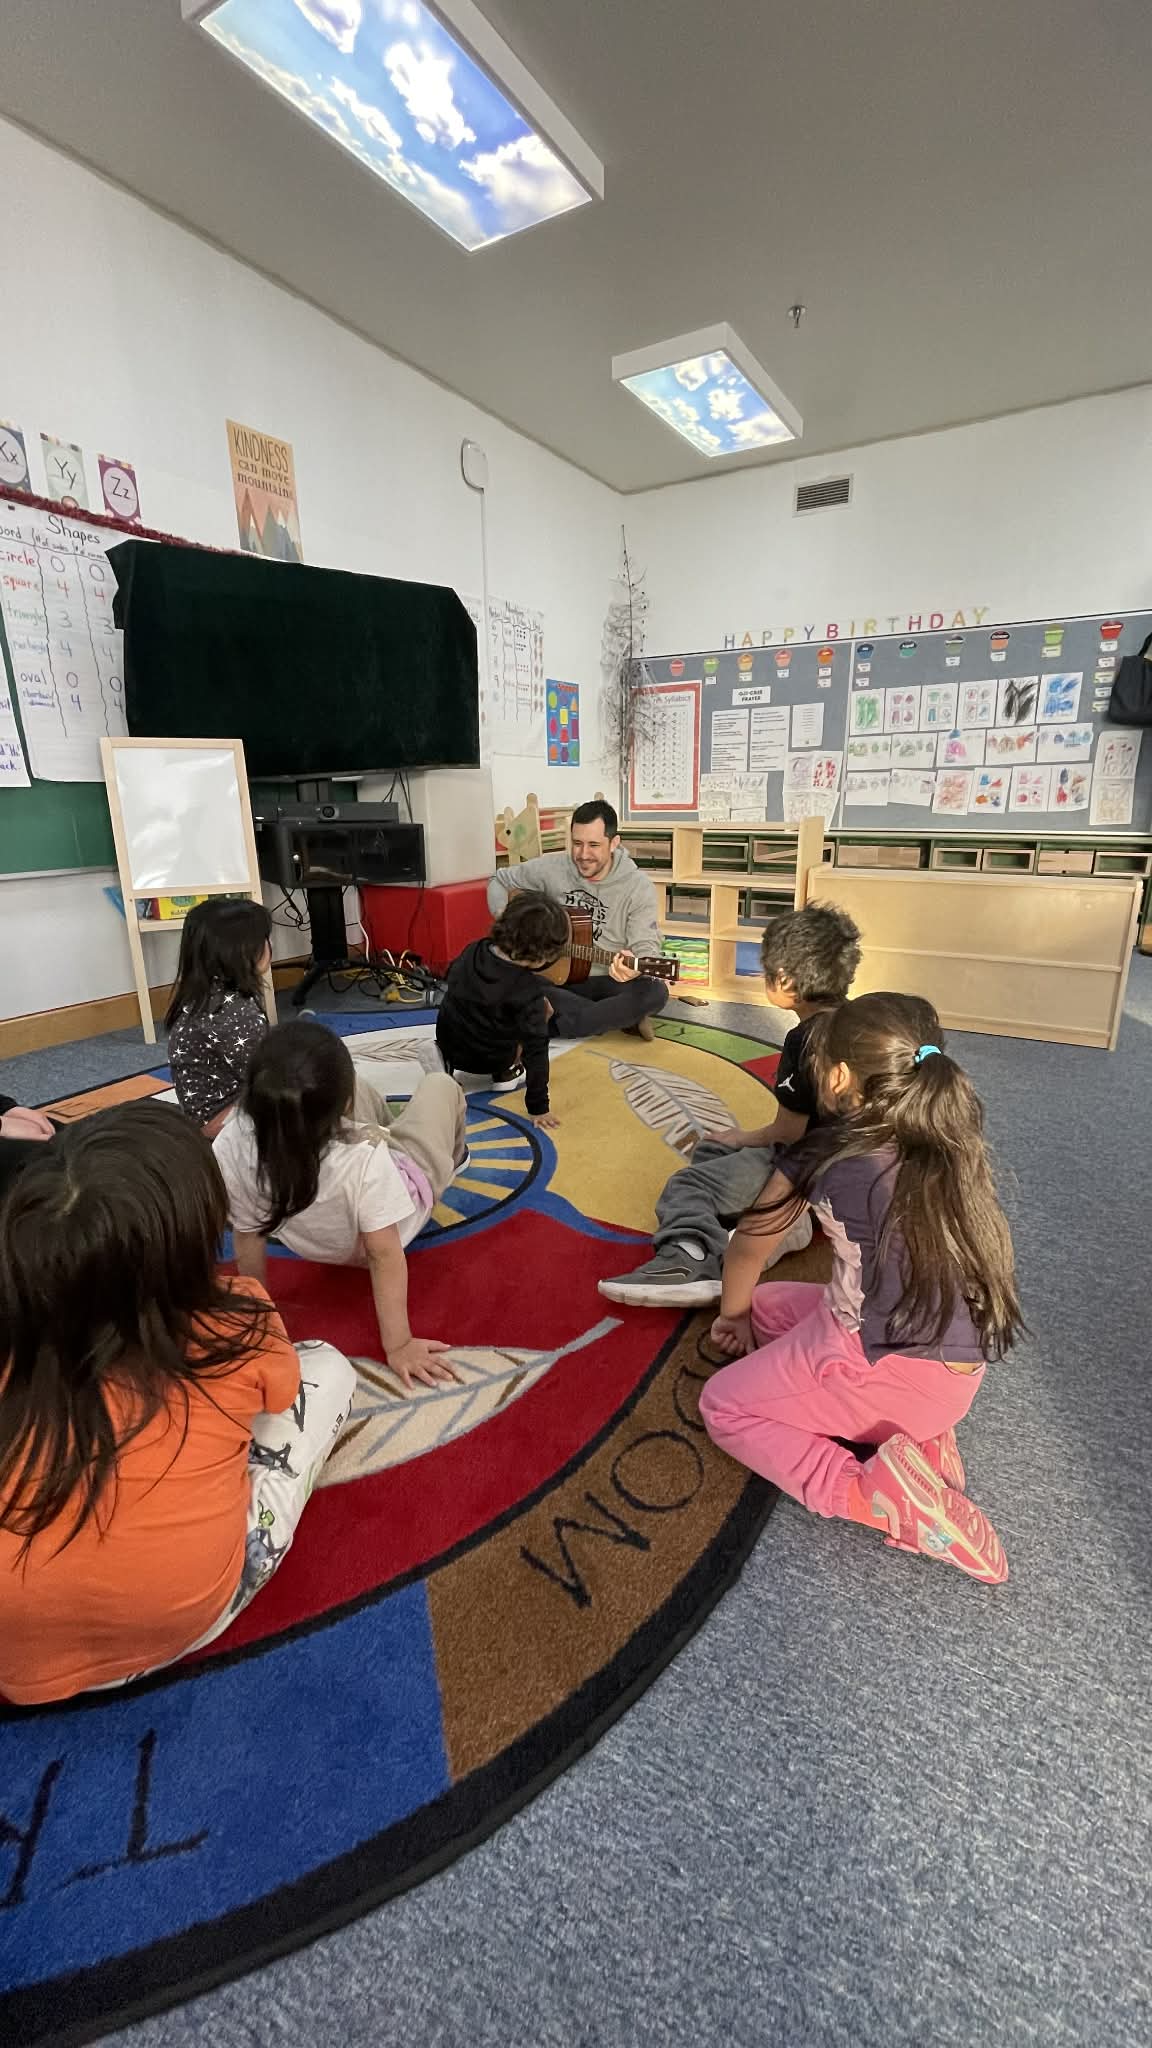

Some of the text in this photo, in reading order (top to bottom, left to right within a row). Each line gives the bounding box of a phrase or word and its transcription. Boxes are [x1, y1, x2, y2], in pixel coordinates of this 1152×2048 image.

[233, 424, 289, 473] KINDNESS
[54, 456, 77, 490] Yy
[238, 459, 289, 485] can move
[111, 475, 131, 500] Zz
[46, 513, 101, 546] Shapes
[3, 574, 106, 606] square 4 4
[59, 610, 73, 629] 3
[99, 616, 116, 635] 3
[724, 606, 989, 649] HAPPY BIRTHDAY
[61, 640, 73, 659] 4
[102, 644, 115, 664] 4
[20, 667, 48, 685] oval
[71, 693, 83, 712] 4
[113, 696, 125, 714] 4
